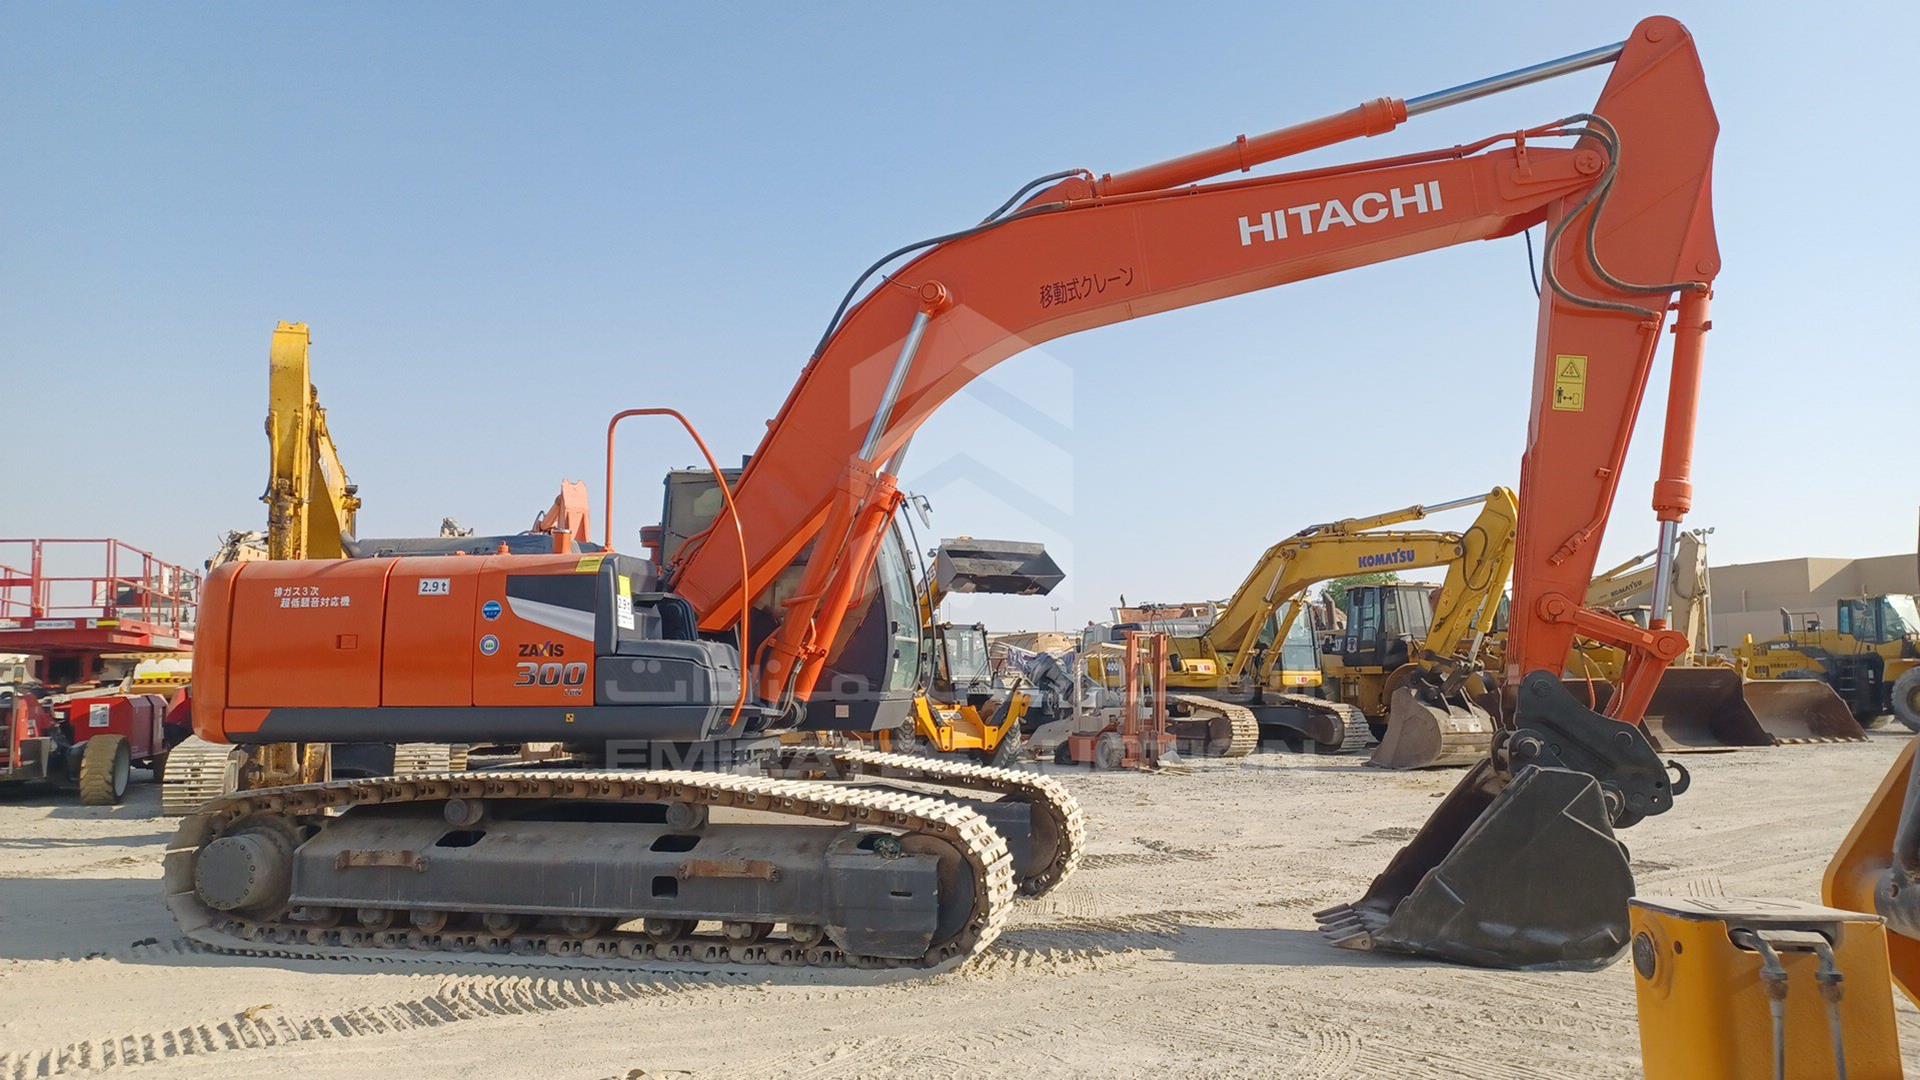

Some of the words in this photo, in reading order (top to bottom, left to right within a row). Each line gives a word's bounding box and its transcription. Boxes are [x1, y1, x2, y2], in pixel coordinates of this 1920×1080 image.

[1238, 180, 1443, 246] HITACHI
[1040, 267, 1133, 309] 移動式クレーン
[1359, 548, 1415, 568] KOMATSU
[421, 581, 439, 593] 2.9
[441, 581, 447, 592] t
[518, 640, 564, 657] ZAXIS
[514, 661, 588, 687] 300
